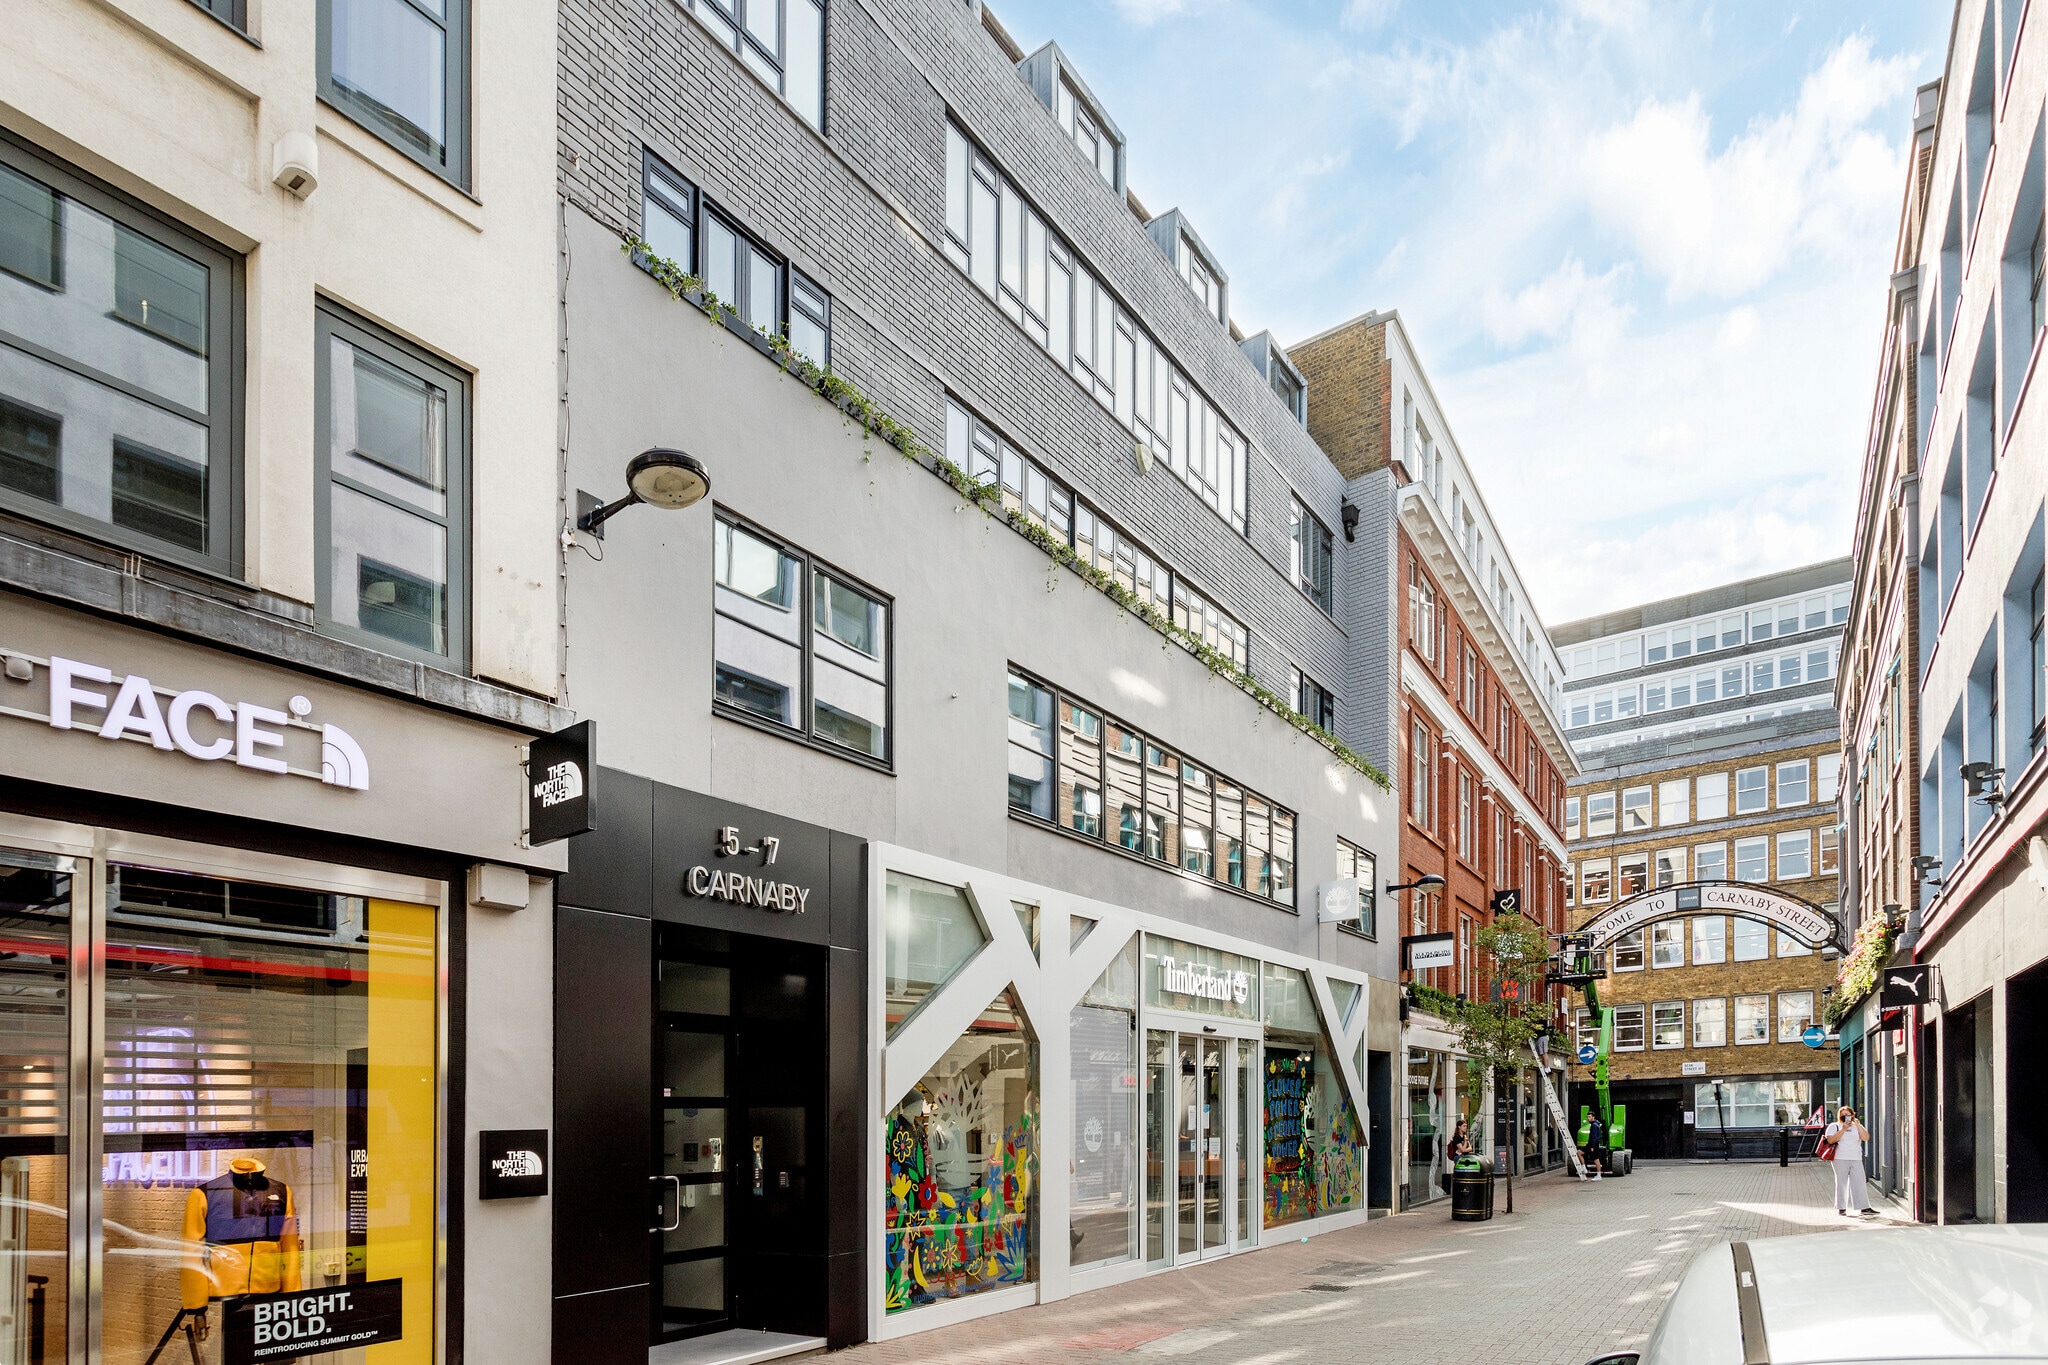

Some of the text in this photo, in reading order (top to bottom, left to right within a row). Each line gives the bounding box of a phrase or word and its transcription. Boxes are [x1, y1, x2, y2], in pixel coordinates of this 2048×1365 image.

[49, 655, 288, 775] FACE
[547, 762, 566, 780] THE
[534, 776, 565, 798] NORTH
[543, 788, 566, 808] FACE
[688, 866, 810, 914] CARNABY
[1646, 900, 1665, 912] TO
[1707, 891, 1775, 911] CARNABY
[1776, 904, 1826, 936] STREET
[1162, 955, 1232, 1002] Timberland
[1266, 1078, 1302, 1102] FLOWER
[1269, 1099, 1300, 1121] POWER
[1266, 1119, 1302, 1142] IS PEOPLE
[506, 1150, 526, 1160] THE
[1272, 1139, 1299, 1161] POWER
[492, 1159, 525, 1169] NORTH
[501, 1168, 526, 1177] FACE
[254, 1292, 354, 1324] BRIGHT.
[254, 1316, 332, 1344] BOLD.
[254, 1340, 319, 1357] REINTRODUCING
[320, 1334, 350, 1346] SUMMIT
